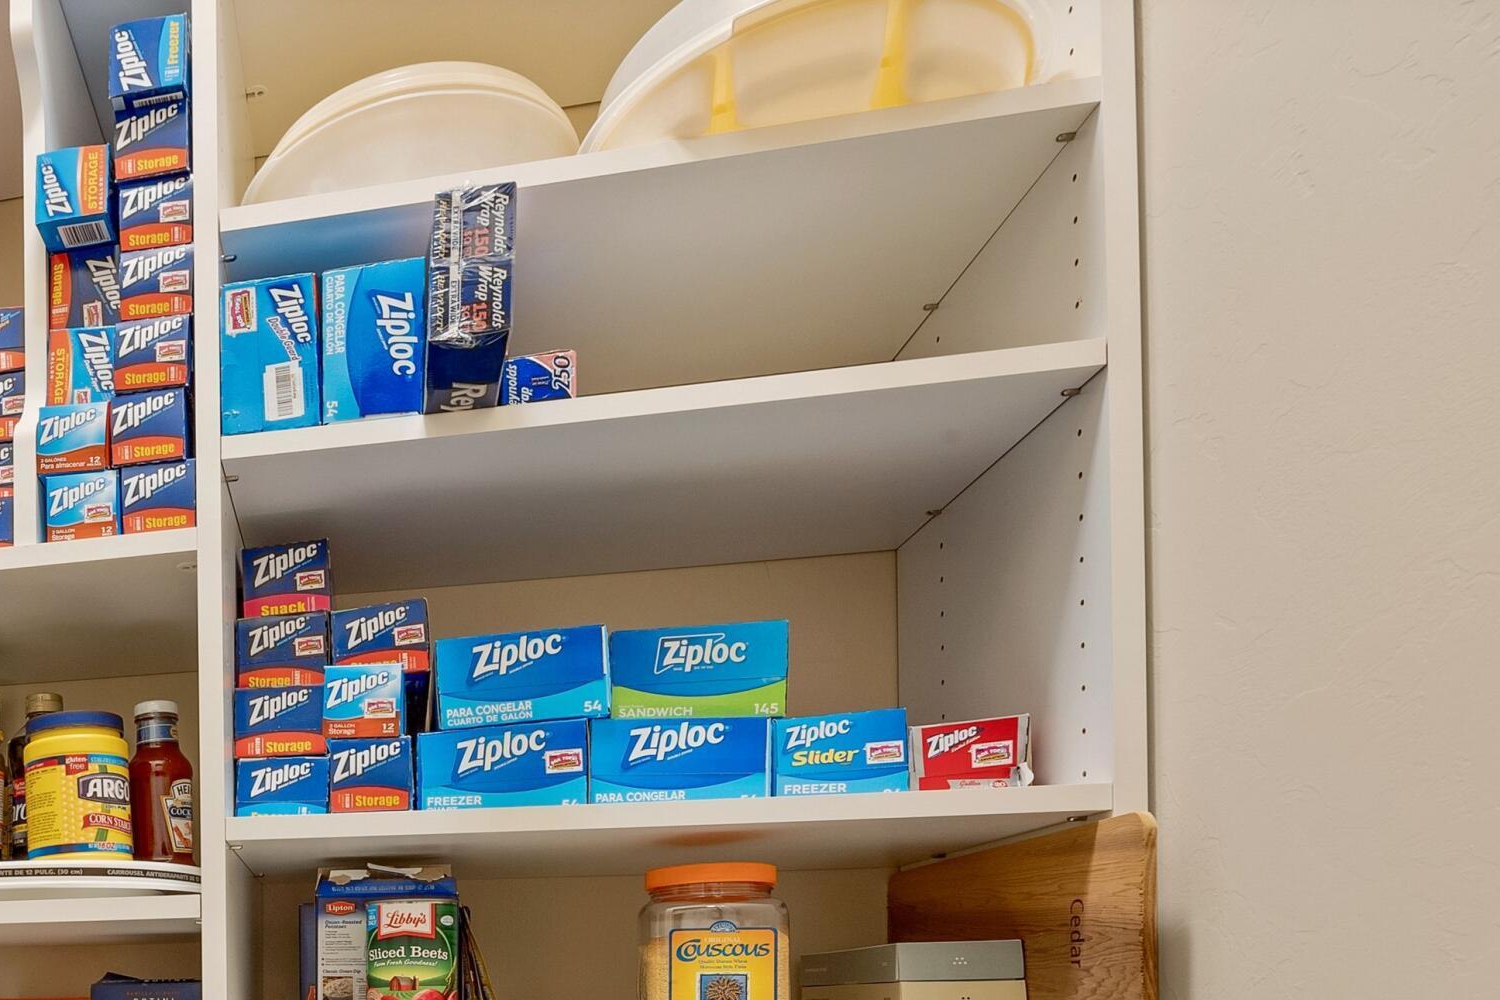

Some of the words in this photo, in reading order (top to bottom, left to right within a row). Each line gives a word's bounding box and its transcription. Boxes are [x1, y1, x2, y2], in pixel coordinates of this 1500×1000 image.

[168, 21, 179, 65] Freezer
[116, 30, 153, 92] Ziploc
[116, 103, 178, 151] Ziploc
[137, 155, 178, 172] Storage
[43, 164, 74, 217] Ziploc
[88, 152, 99, 209] STORAGE
[122, 178, 187, 221] Ziploc
[129, 232, 170, 246] Storage
[494, 192, 509, 254] Reynolds
[86, 256, 121, 310] Ziploc
[122, 246, 186, 288] Ziploc
[474, 265, 489, 301] Wrap
[52, 263, 64, 305] Storage
[335, 275, 345, 299] PARA
[492, 267, 507, 329] Reynolds
[128, 302, 169, 316] Storage
[269, 284, 312, 344] Ziploc
[326, 313, 332, 324] DE
[472, 304, 487, 332] 150
[118, 316, 183, 357] Ziploc
[335, 302, 346, 353] CONGELAR
[376, 292, 418, 377] Ziploc
[55, 348, 66, 404] STORAGE
[79, 331, 115, 391] Ziploc
[552, 355, 570, 391] 250
[125, 372, 166, 385] Storage
[112, 391, 175, 436] Ziploc
[326, 401, 338, 417] 54
[40, 408, 96, 447] Ziploc
[89, 456, 101, 465] 12
[134, 442, 175, 458] Storage
[49, 477, 106, 517] Ziploc
[124, 463, 186, 508] Ziploc
[101, 526, 113, 536] 12
[146, 515, 187, 530] Storage
[253, 543, 318, 588] Ziploc
[261, 602, 306, 616] Snack
[249, 617, 307, 657] Ziploc
[346, 606, 407, 650] Ziploc
[472, 633, 563, 679] Ziploc
[663, 638, 746, 672] Ziploc
[248, 676, 291, 688] Storage
[326, 671, 390, 709] Ziploc
[249, 689, 309, 726] Ziploc
[447, 704, 473, 719] PARA
[476, 700, 533, 716] CONGELAR
[447, 716, 483, 727] CUARTO
[486, 714, 498, 723] DE
[583, 700, 602, 712] 54
[618, 706, 693, 718] SANDWICH
[754, 702, 779, 715] 145
[382, 723, 394, 731] 12
[628, 722, 725, 761] Ziploc
[786, 718, 851, 750] Ziploc
[926, 725, 978, 759] Ziploc
[265, 740, 312, 753] Storage
[333, 742, 400, 784] Ziploc
[457, 730, 546, 774] Ziploc
[791, 749, 860, 767] Slider
[69, 762, 85, 770] free
[250, 763, 312, 798] Ziploc
[86, 776, 130, 801] ARGO
[355, 794, 400, 806] Storage
[426, 797, 482, 807] FREEZER
[595, 792, 624, 803] PARA
[626, 790, 685, 801] CONGELAR
[784, 783, 847, 795] FREEZER
[89, 813, 112, 825] CORN
[34, 868, 56, 876] PULG.
[107, 869, 145, 877] CARROUSEL
[328, 904, 354, 912] Lipton
[384, 911, 427, 929] Libby's
[1069, 899, 1084, 968] Cedar
[369, 946, 406, 961] Sliced
[410, 946, 449, 961] Beets
[676, 939, 770, 962] Couscous
